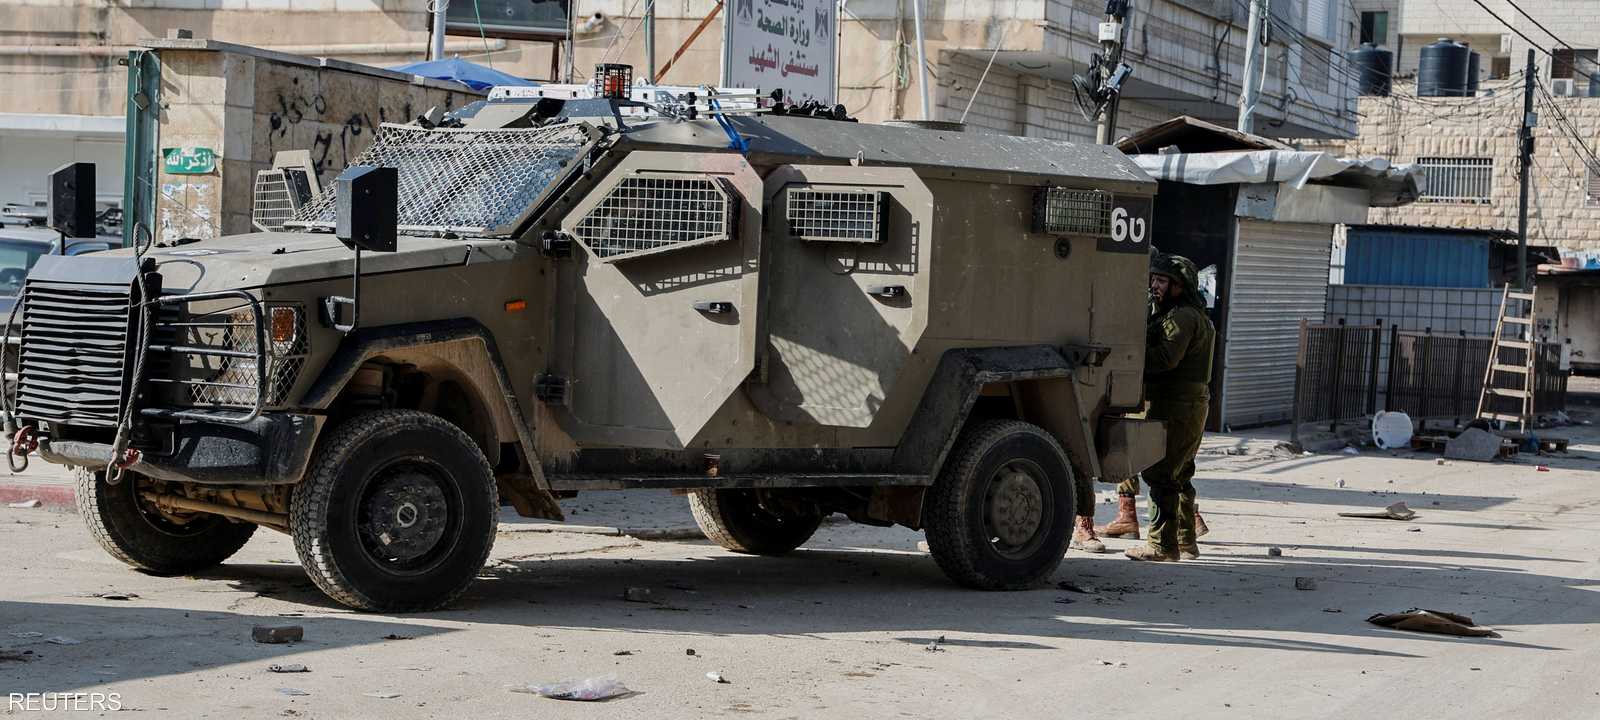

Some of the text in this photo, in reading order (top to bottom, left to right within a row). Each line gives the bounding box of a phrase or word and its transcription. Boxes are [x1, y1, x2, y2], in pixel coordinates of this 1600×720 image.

[757, 9, 810, 47] وزارة الصحة
[749, 43, 819, 77] مستشفى الشهيد
[166, 152, 184, 166] الله
